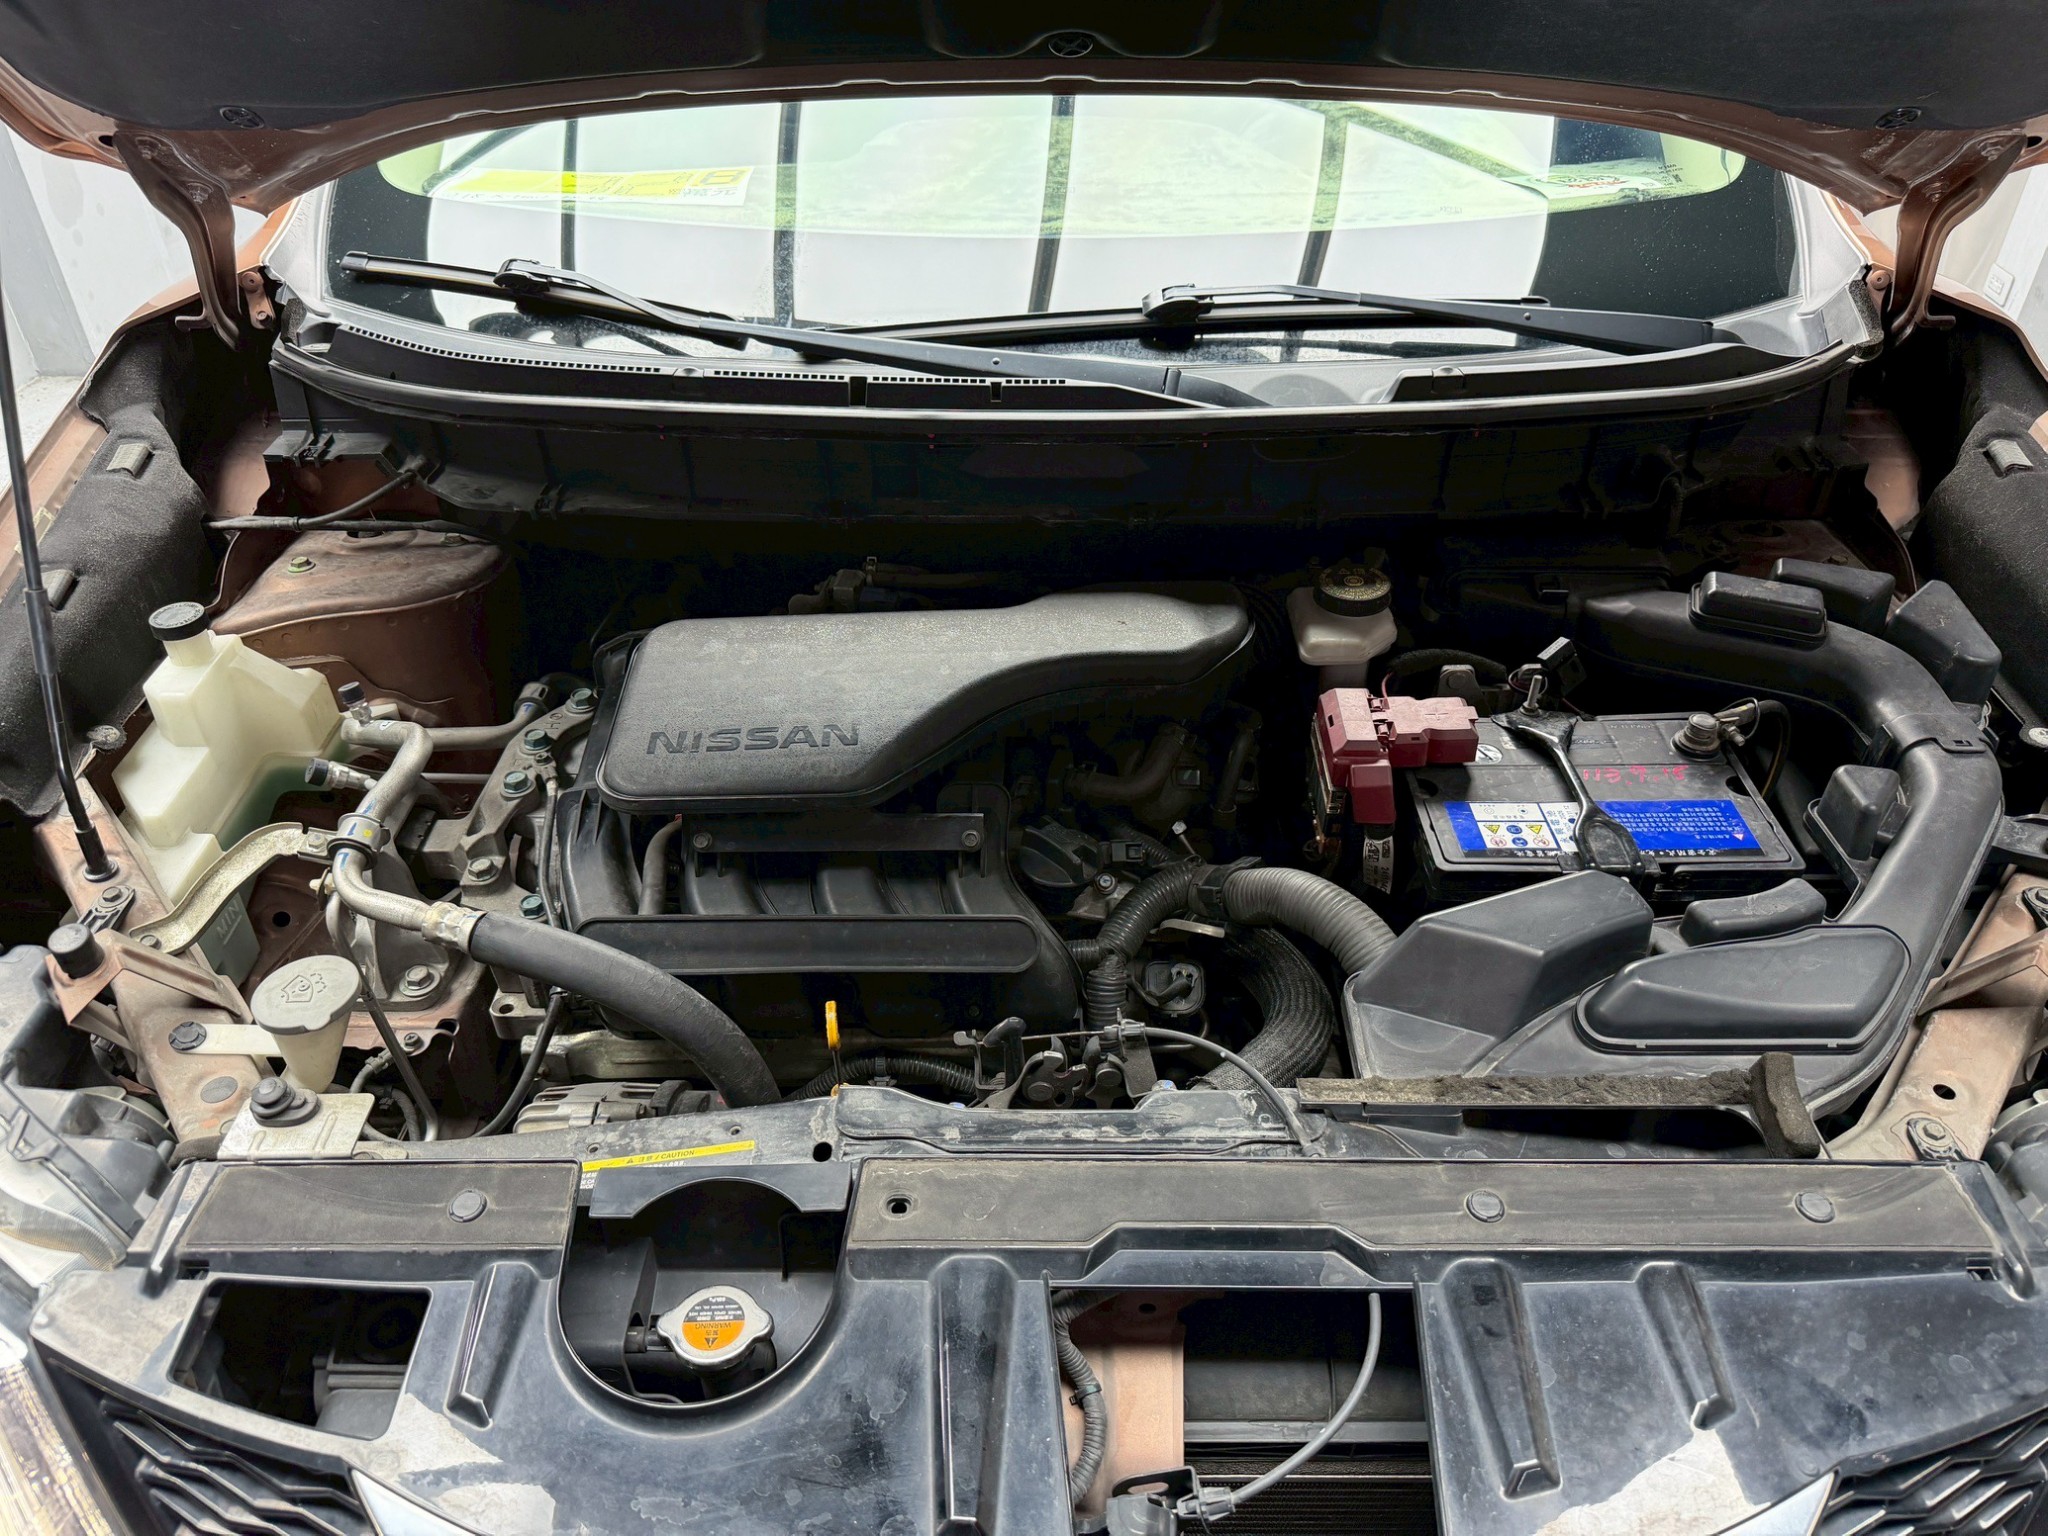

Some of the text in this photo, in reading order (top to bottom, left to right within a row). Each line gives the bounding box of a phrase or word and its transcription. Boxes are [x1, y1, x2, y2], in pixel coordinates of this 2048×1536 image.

[646, 723, 860, 755] NISSAN
[216, 899, 241, 938] MIN
[661, 1149, 695, 1161] CAUTION
[695, 1322, 732, 1330] WARNING
